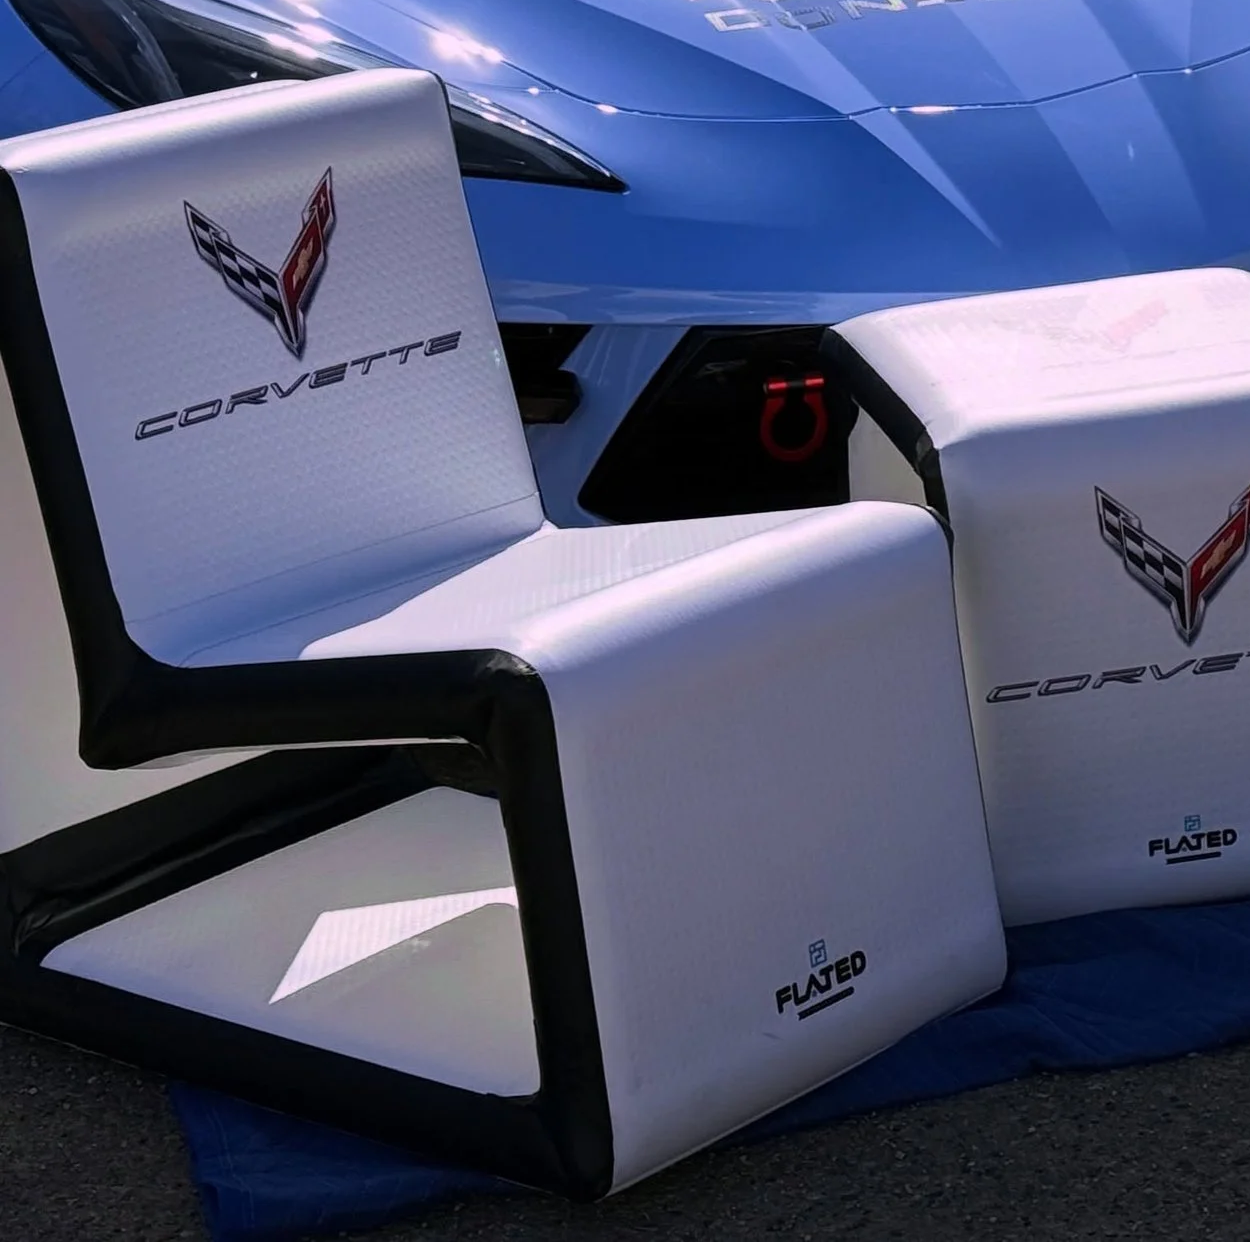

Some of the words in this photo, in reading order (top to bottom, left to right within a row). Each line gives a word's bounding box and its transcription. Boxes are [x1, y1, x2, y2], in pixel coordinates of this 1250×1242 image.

[135, 330, 462, 440] CORVETTE
[1148, 828, 1238, 857] FLATED
[775, 950, 867, 1014] FLATED
